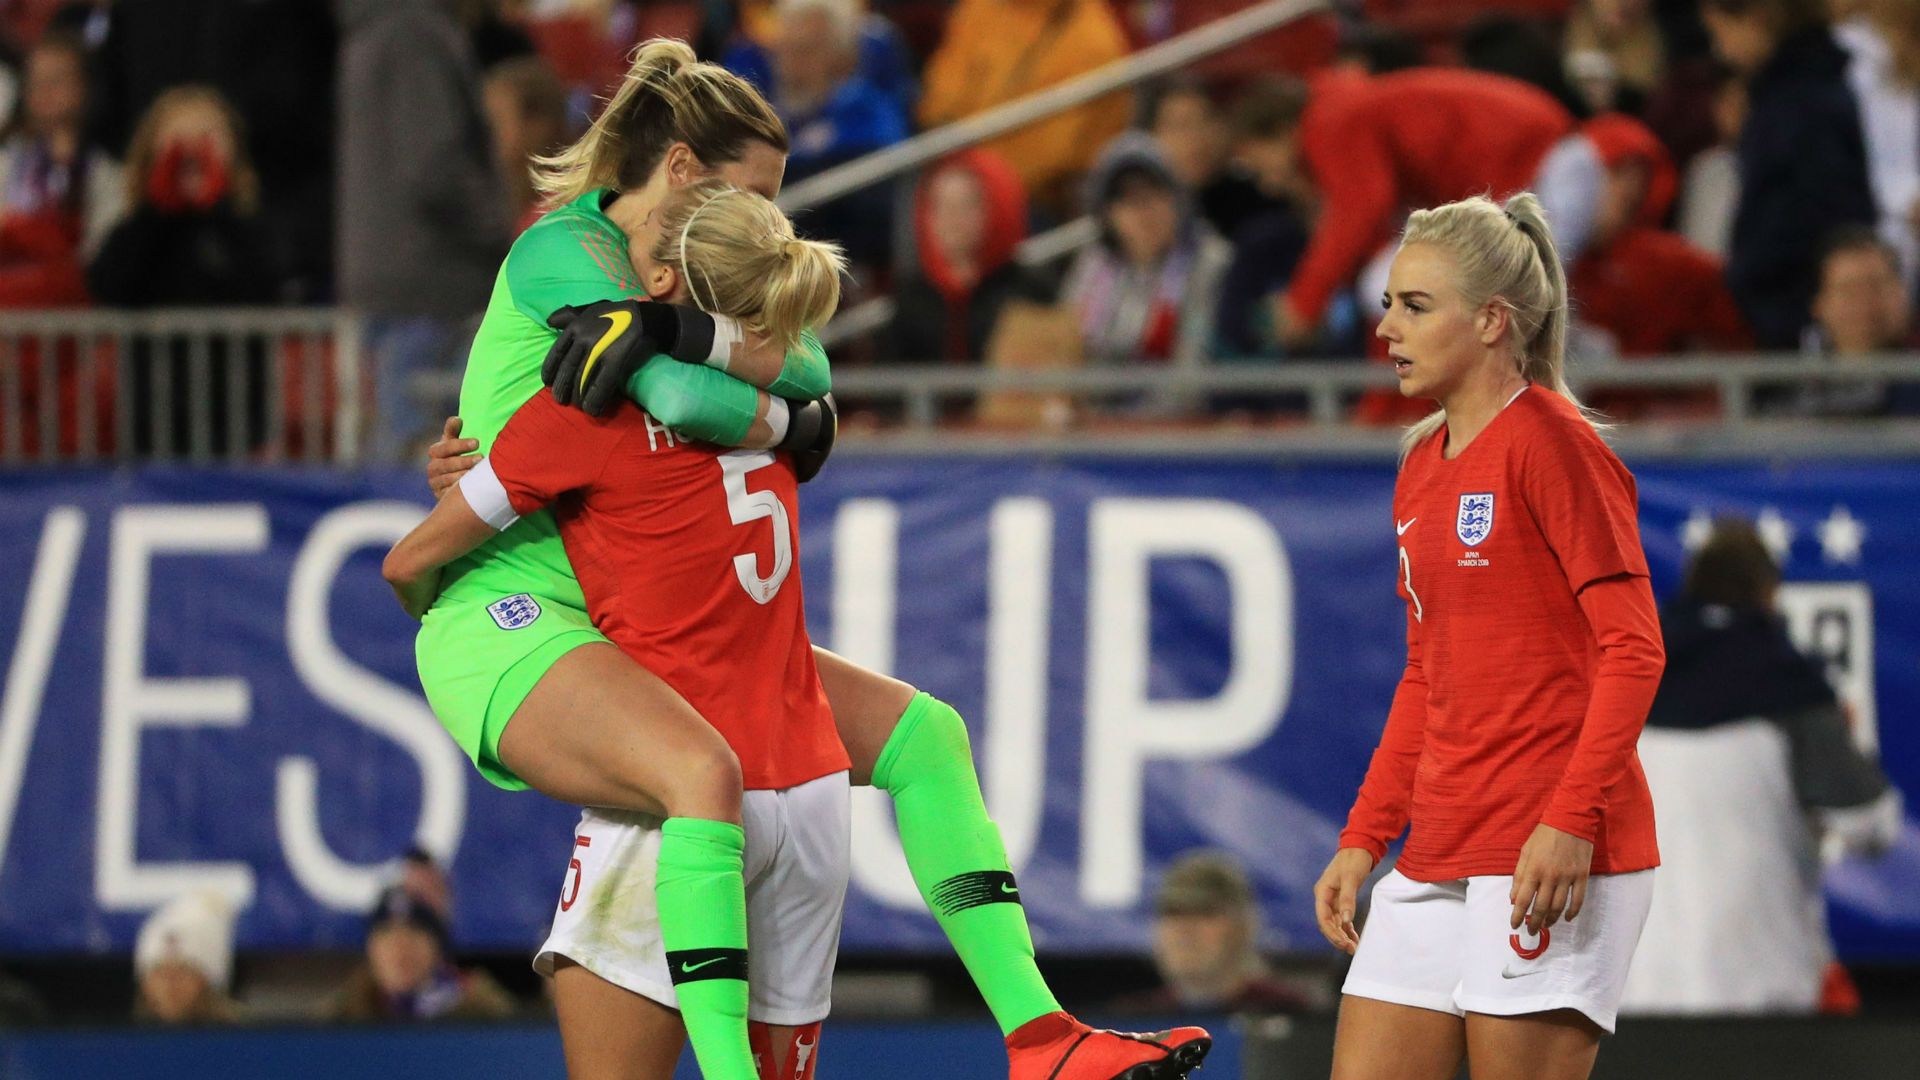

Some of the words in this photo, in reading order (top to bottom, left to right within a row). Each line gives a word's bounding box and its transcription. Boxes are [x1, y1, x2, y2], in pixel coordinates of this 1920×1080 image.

[716, 448, 793, 605] 5
[828, 496, 1294, 910] UP
[561, 835, 591, 912] 5
